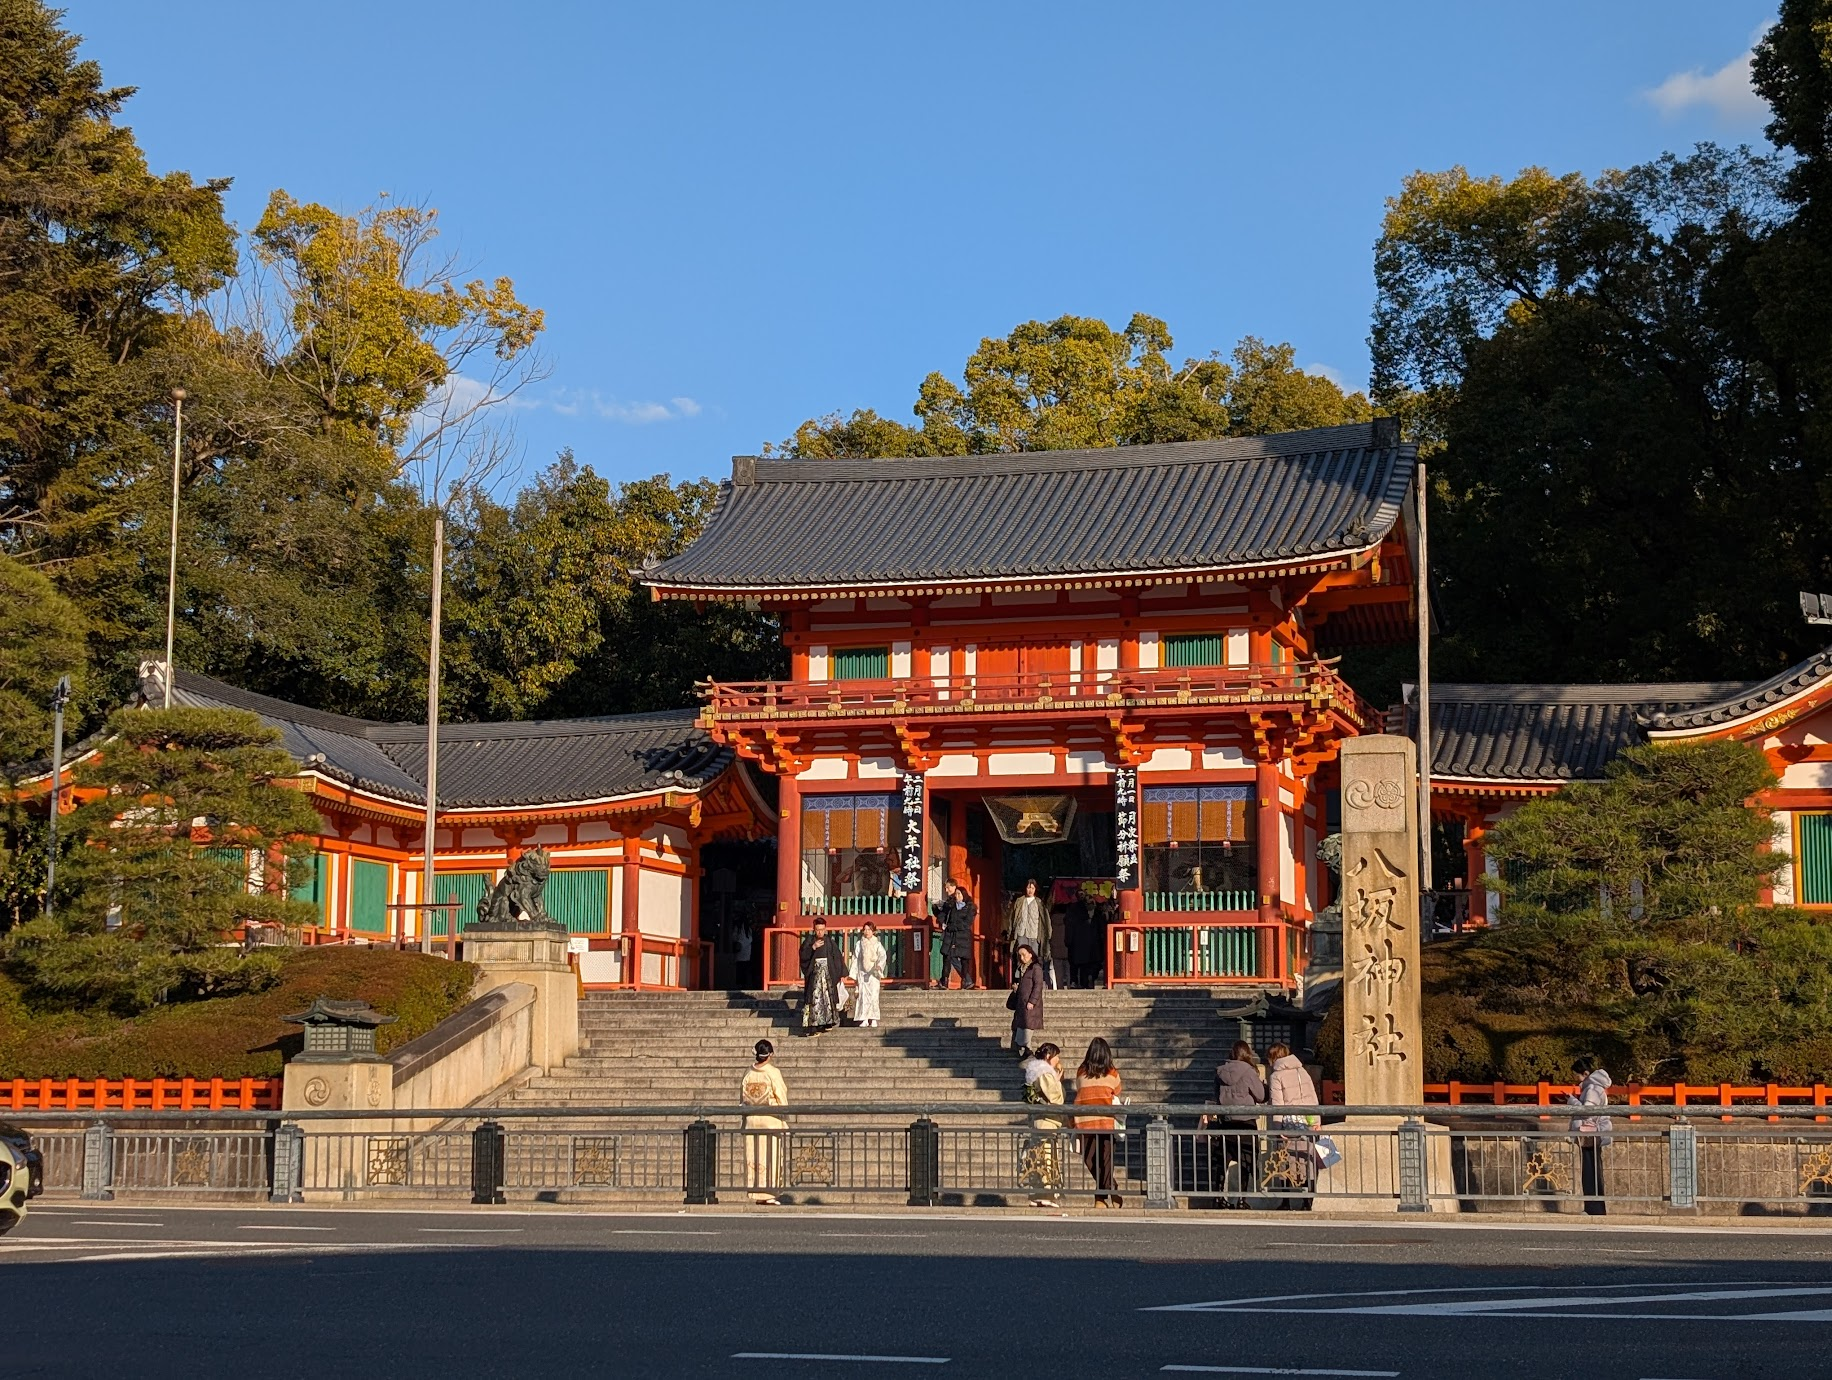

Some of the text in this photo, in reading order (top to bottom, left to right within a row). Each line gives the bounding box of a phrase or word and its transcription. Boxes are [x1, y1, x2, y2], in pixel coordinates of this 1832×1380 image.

[913, 775, 924, 814] 二月二日
[1116, 768, 1127, 807] 午前九時
[1126, 769, 1136, 803] 二月一日
[903, 819, 921, 890] 大年社祭
[1116, 811, 1131, 883] 節分祈願祭
[1346, 847, 1407, 1066] 八坂神社
